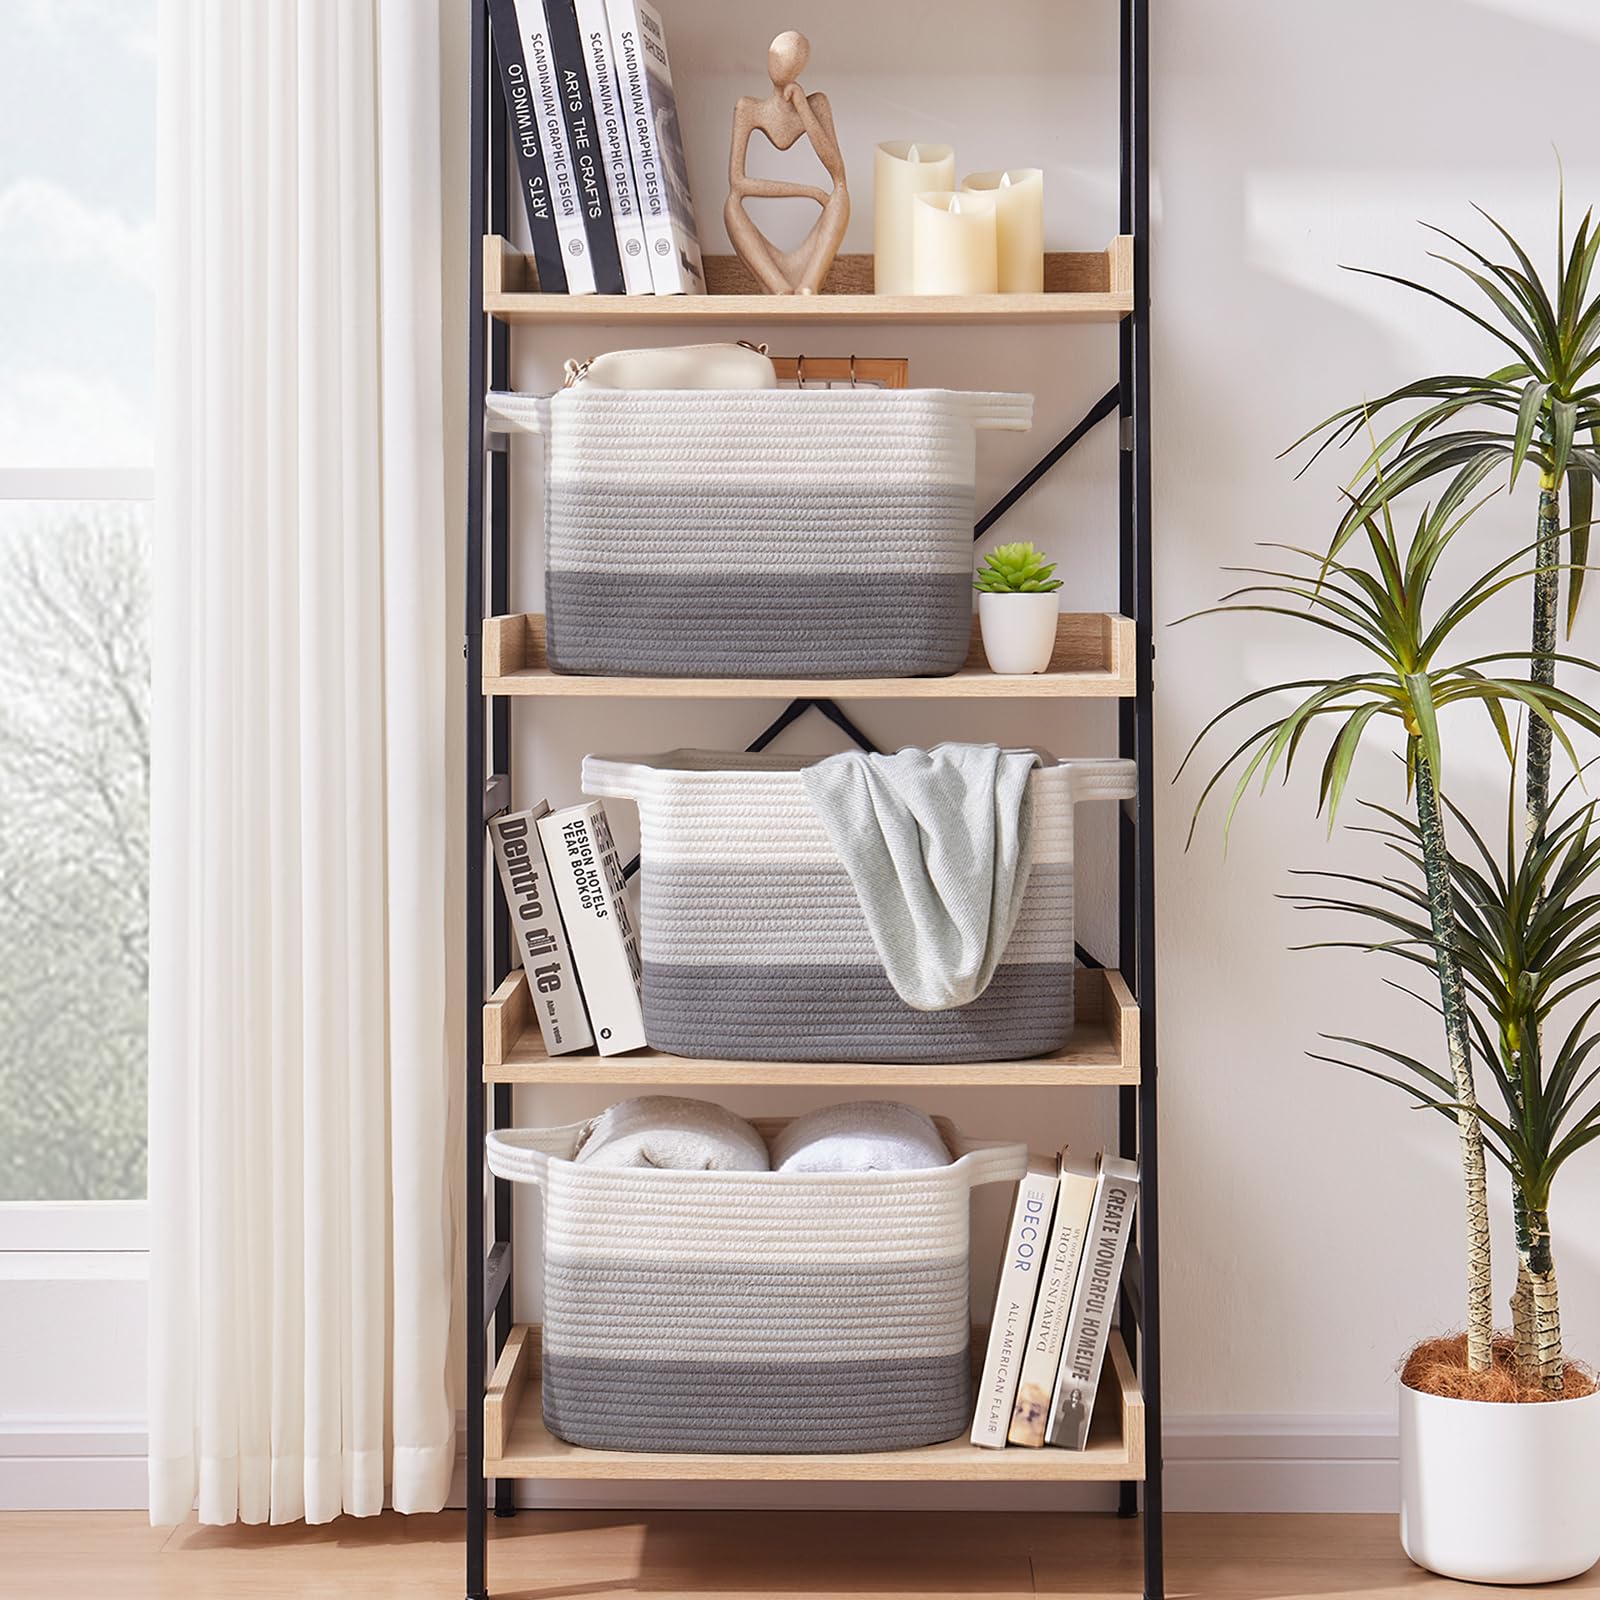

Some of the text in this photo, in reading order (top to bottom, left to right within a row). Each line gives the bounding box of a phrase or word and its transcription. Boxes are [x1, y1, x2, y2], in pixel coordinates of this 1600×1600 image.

[547, 119, 566, 171] GRAPHIC
[557, 173, 575, 216] DESIGN
[563, 70, 602, 219] ARTS THE CRAFTS
[605, 118, 625, 171] GRAPHIC
[615, 172, 632, 216] DESIGN
[636, 118, 655, 171] GRAPHIC
[645, 171, 662, 216] DESIGN
[529, 176, 549, 219] ARTS
[562, 822, 580, 857] YEAR
[573, 820, 608, 918] DESIGN HOTELS
[498, 818, 562, 994] Dentro di te
[1014, 1200, 1043, 1272] DECOR
[1072, 1188, 1128, 1382] CREATE WONDERFUL HOMELIFE
[1036, 1226, 1072, 1352] DARWINS TEORI
[988, 1302, 1020, 1433] ALL-AMERICAN FLAIR
